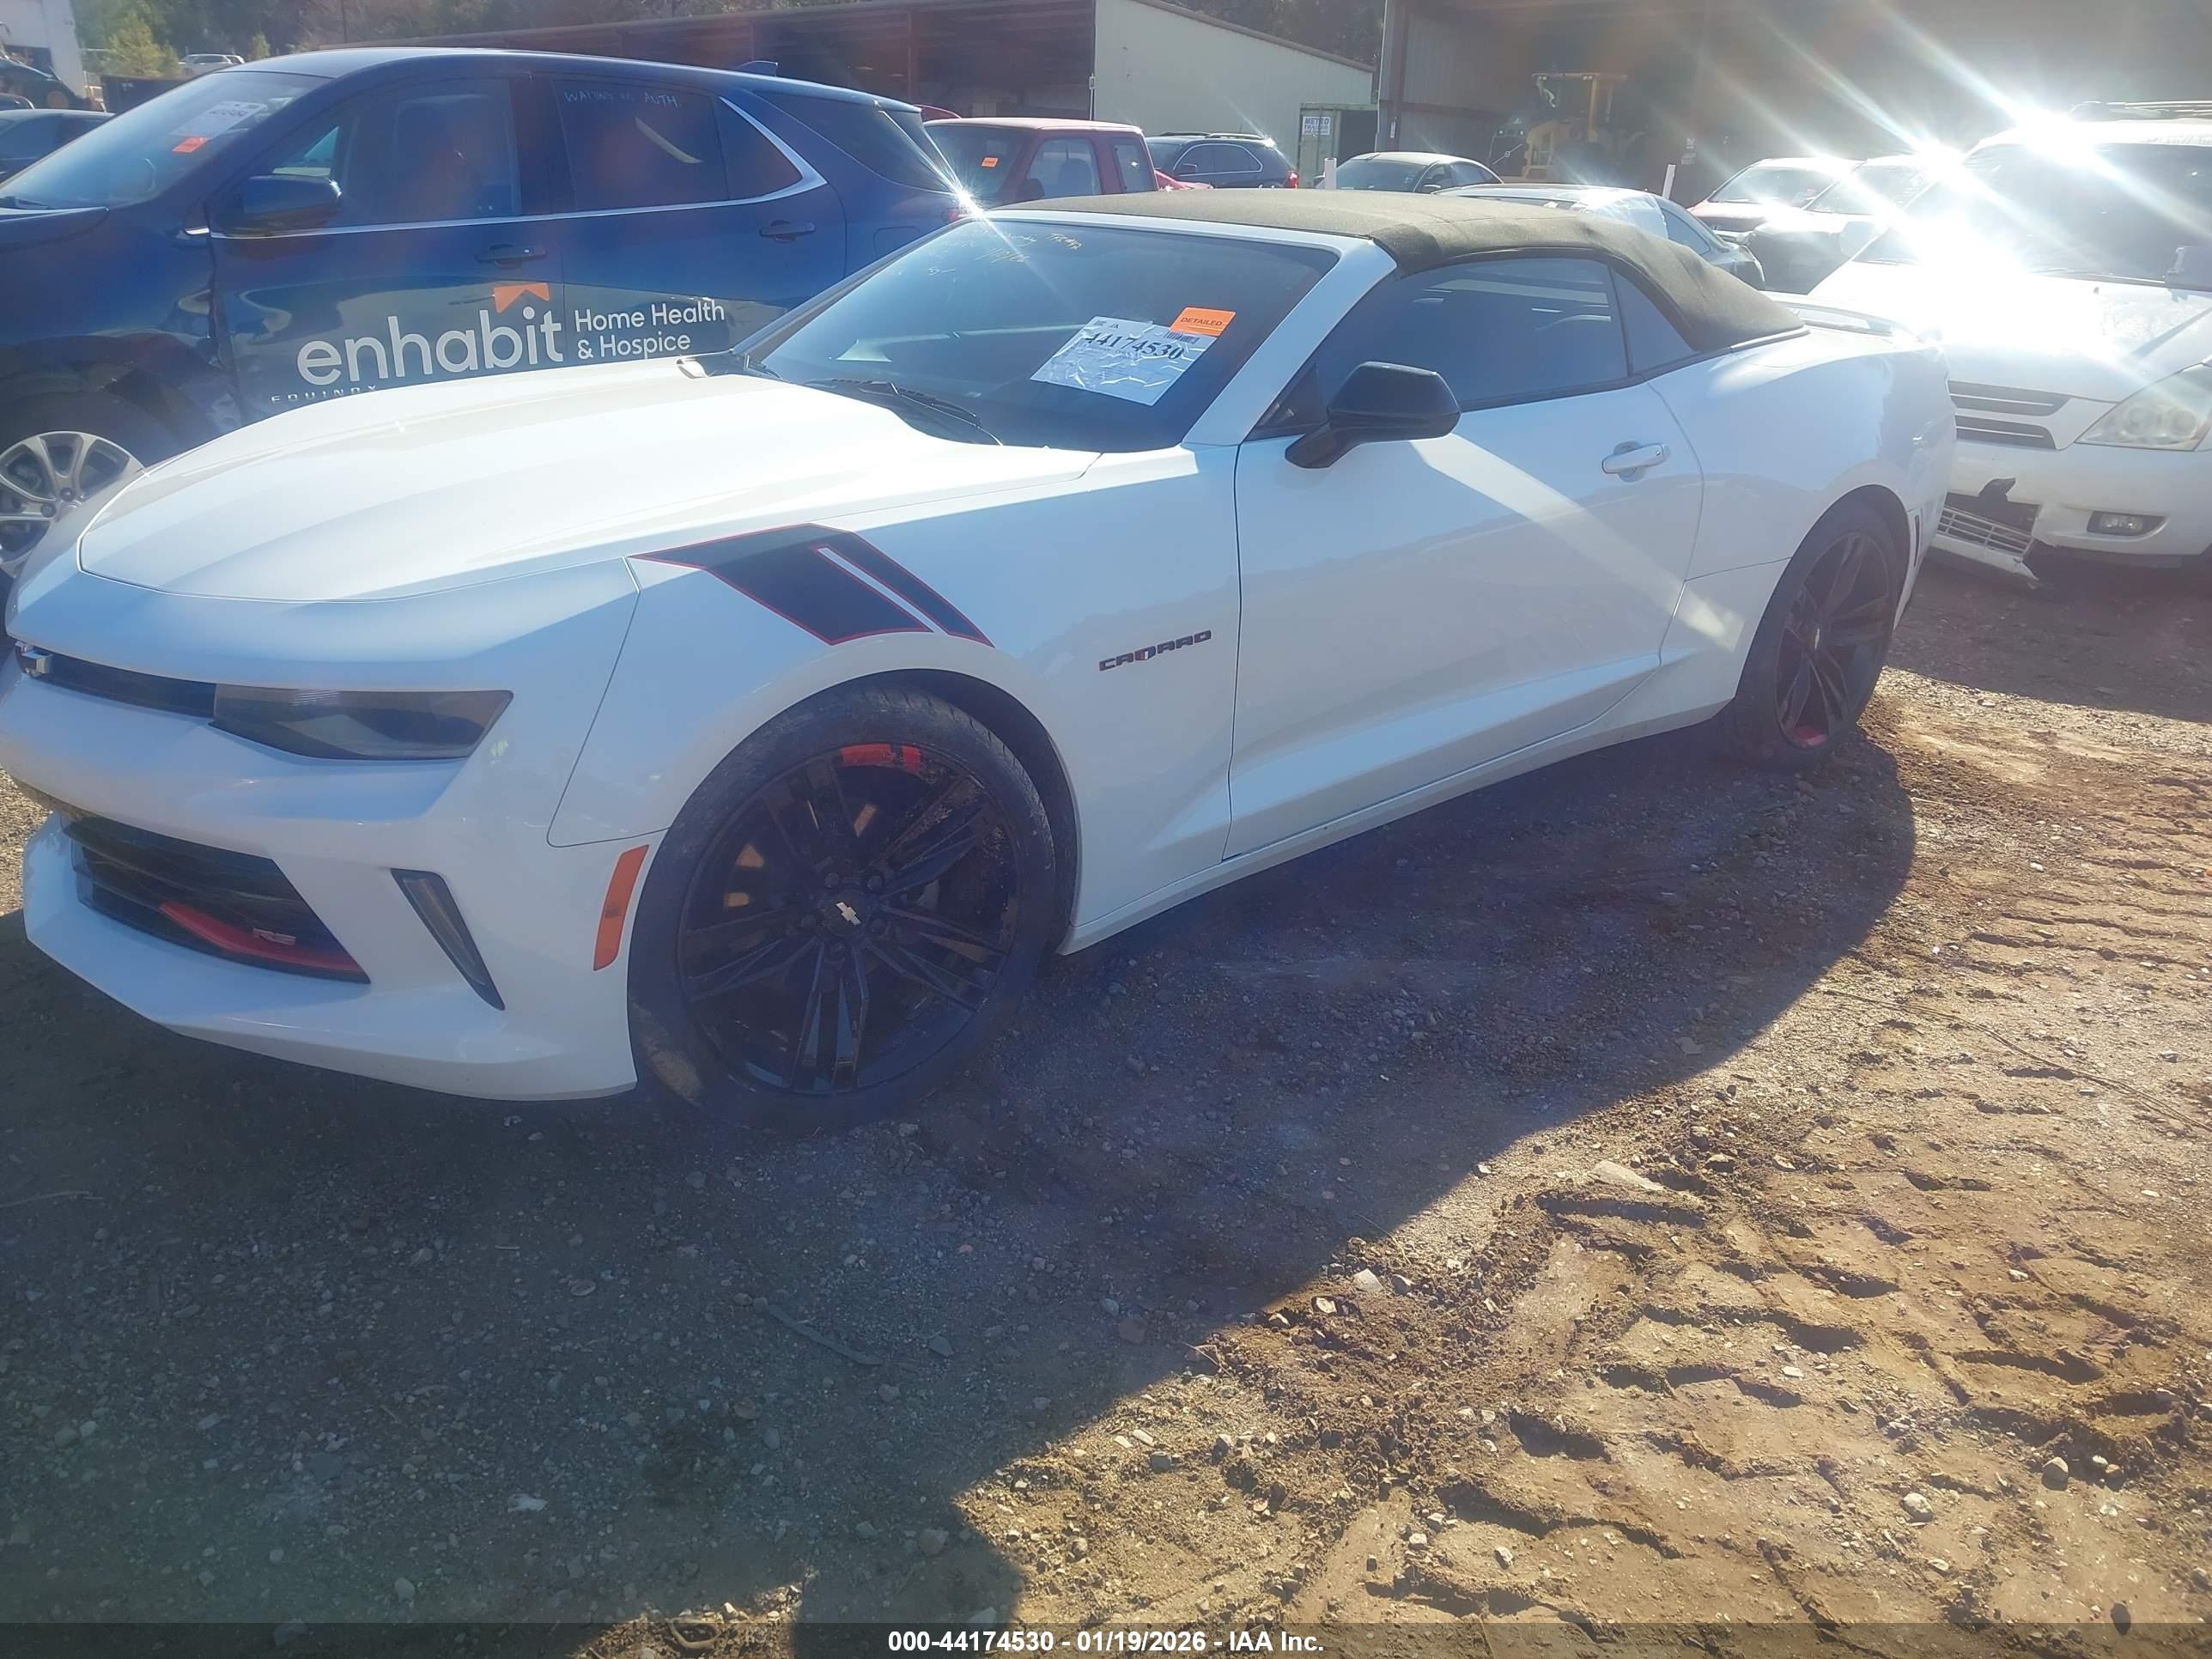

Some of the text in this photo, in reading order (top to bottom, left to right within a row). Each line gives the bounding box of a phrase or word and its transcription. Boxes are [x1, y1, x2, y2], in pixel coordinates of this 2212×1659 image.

[574, 300, 725, 332] Home Health
[1180, 316, 1223, 327] DETAILED
[297, 307, 563, 386] enhabit
[577, 331, 691, 359] & Hospice
[1084, 331, 1185, 360] 44174530
[270, 385, 376, 404] EQUINOX
